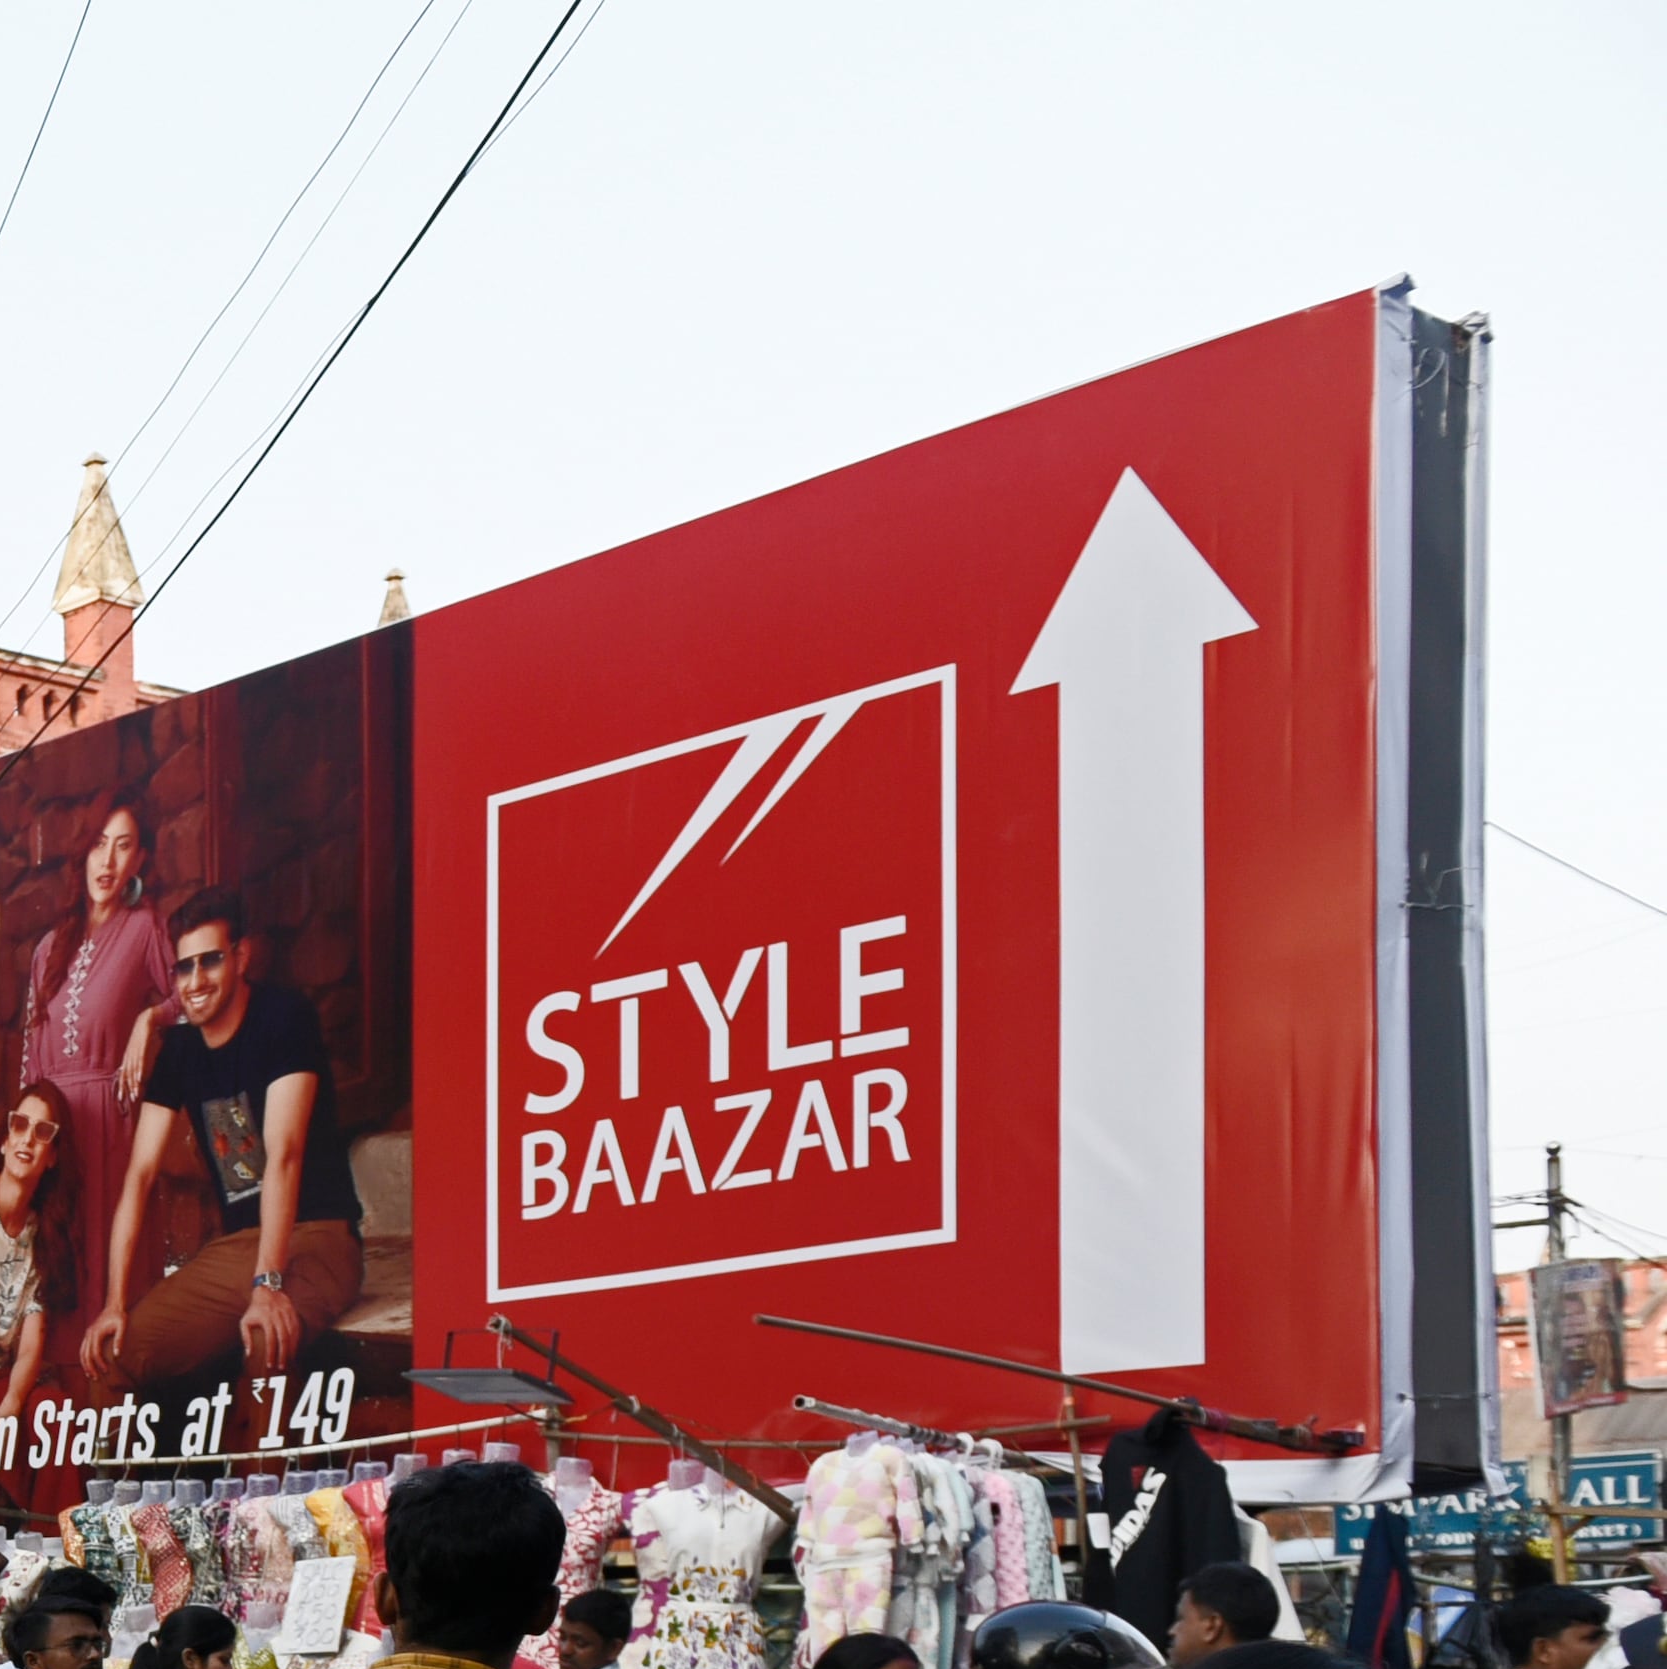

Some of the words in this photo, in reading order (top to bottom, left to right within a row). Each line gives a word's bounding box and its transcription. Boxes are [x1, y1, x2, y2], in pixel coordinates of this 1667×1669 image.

[523, 914, 909, 1115] STYLE
[521, 1068, 911, 1221] BAAZAR
[28, 1392, 161, 1470] Starts
[180, 1380, 232, 1457] at
